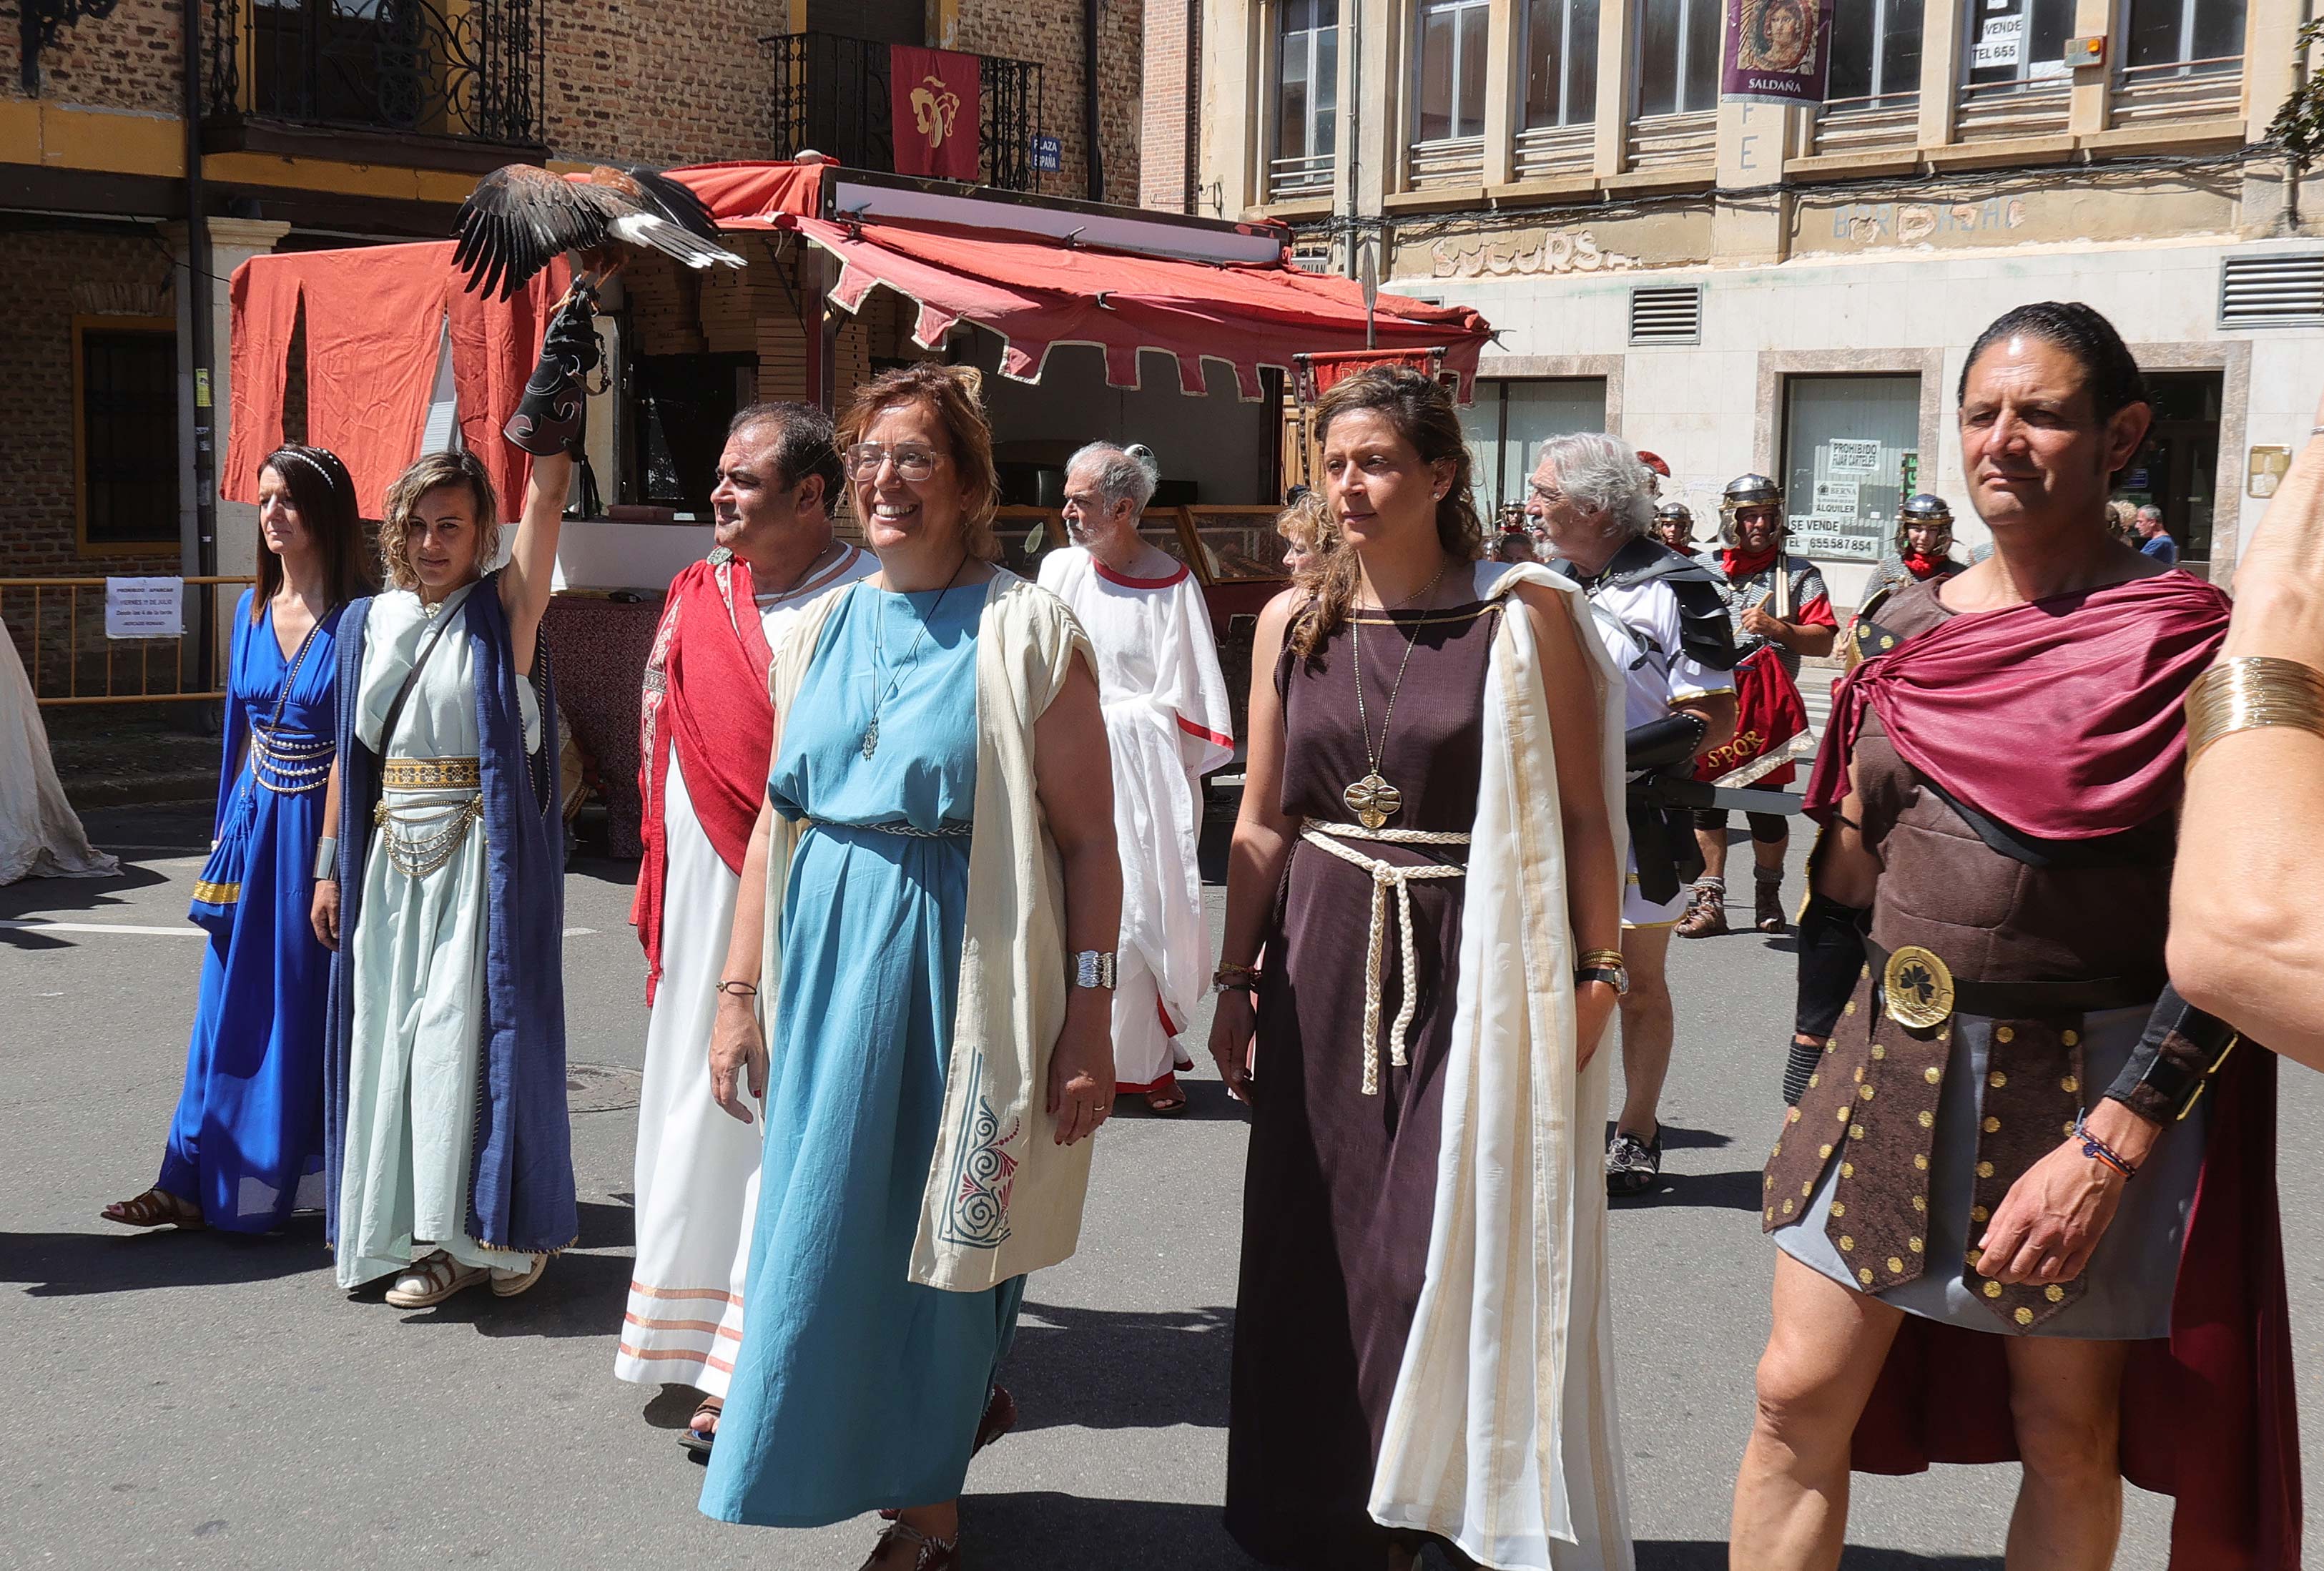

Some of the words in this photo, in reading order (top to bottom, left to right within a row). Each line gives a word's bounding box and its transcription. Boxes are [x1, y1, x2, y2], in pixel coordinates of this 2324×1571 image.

[1984, 19, 2023, 34] VENDE
[1972, 47, 1991, 61] TEL
[1994, 45, 2016, 57] 655
[1748, 78, 1802, 92] SALDAÑA
[1833, 443, 1878, 455] PROHIBIDO
[1832, 454, 1847, 466] FIJAR
[1848, 454, 1876, 467] CARTELES
[1830, 487, 1857, 496] BERNA
[1816, 504, 1855, 513] ALQUILER
[1791, 520, 1804, 531] SE
[1806, 520, 1840, 531] VENDE
[1708, 730, 1766, 768] SPQR
